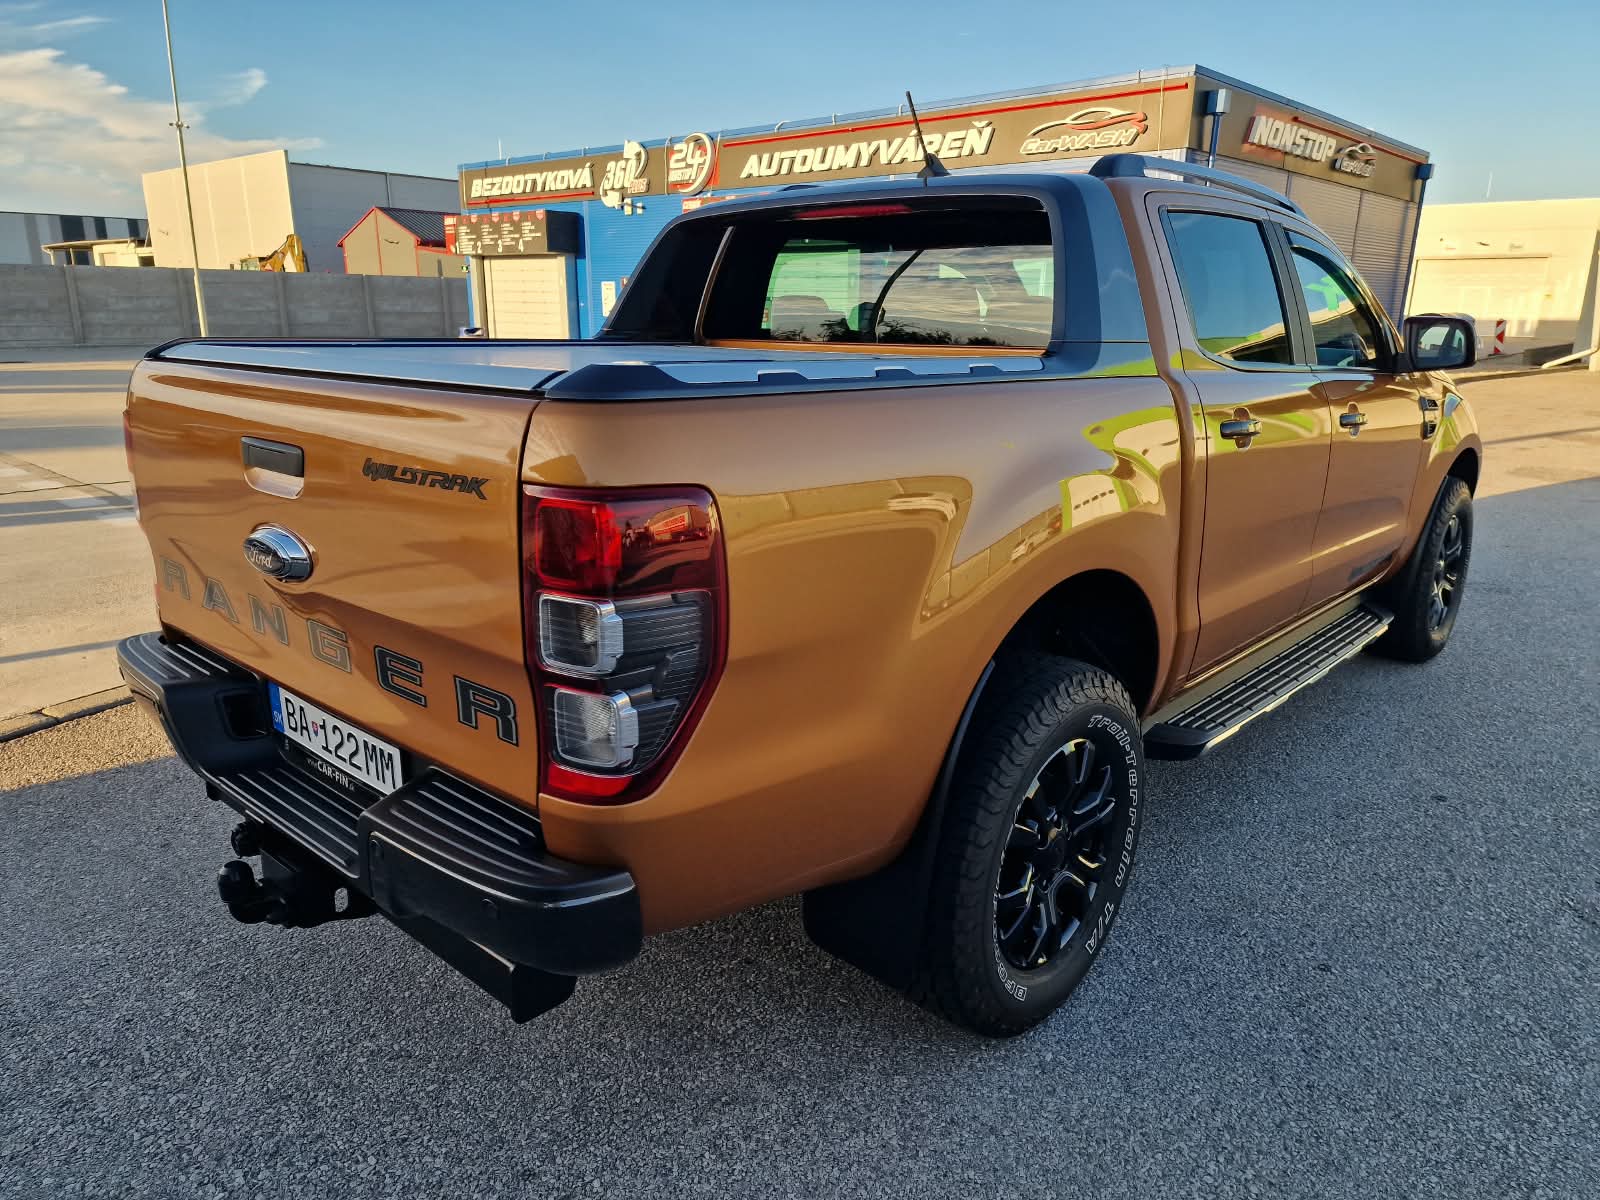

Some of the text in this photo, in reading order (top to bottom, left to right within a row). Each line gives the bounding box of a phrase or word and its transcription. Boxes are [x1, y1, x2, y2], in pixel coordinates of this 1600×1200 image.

[739, 120, 994, 179] AUTOUMYVÁREŇ
[1019, 128, 1139, 155] CarWASH
[1249, 115, 1337, 162] NONSTOP
[470, 162, 594, 198] BEZDOTYKOVÁ
[603, 160, 638, 190] 360
[669, 142, 707, 180] 24
[362, 457, 490, 501] WILDTRAK
[248, 549, 274, 569] Ford
[160, 555, 520, 748] RANGER
[284, 696, 397, 790] BA 122MM
[317, 760, 350, 788] CAR-FIN
